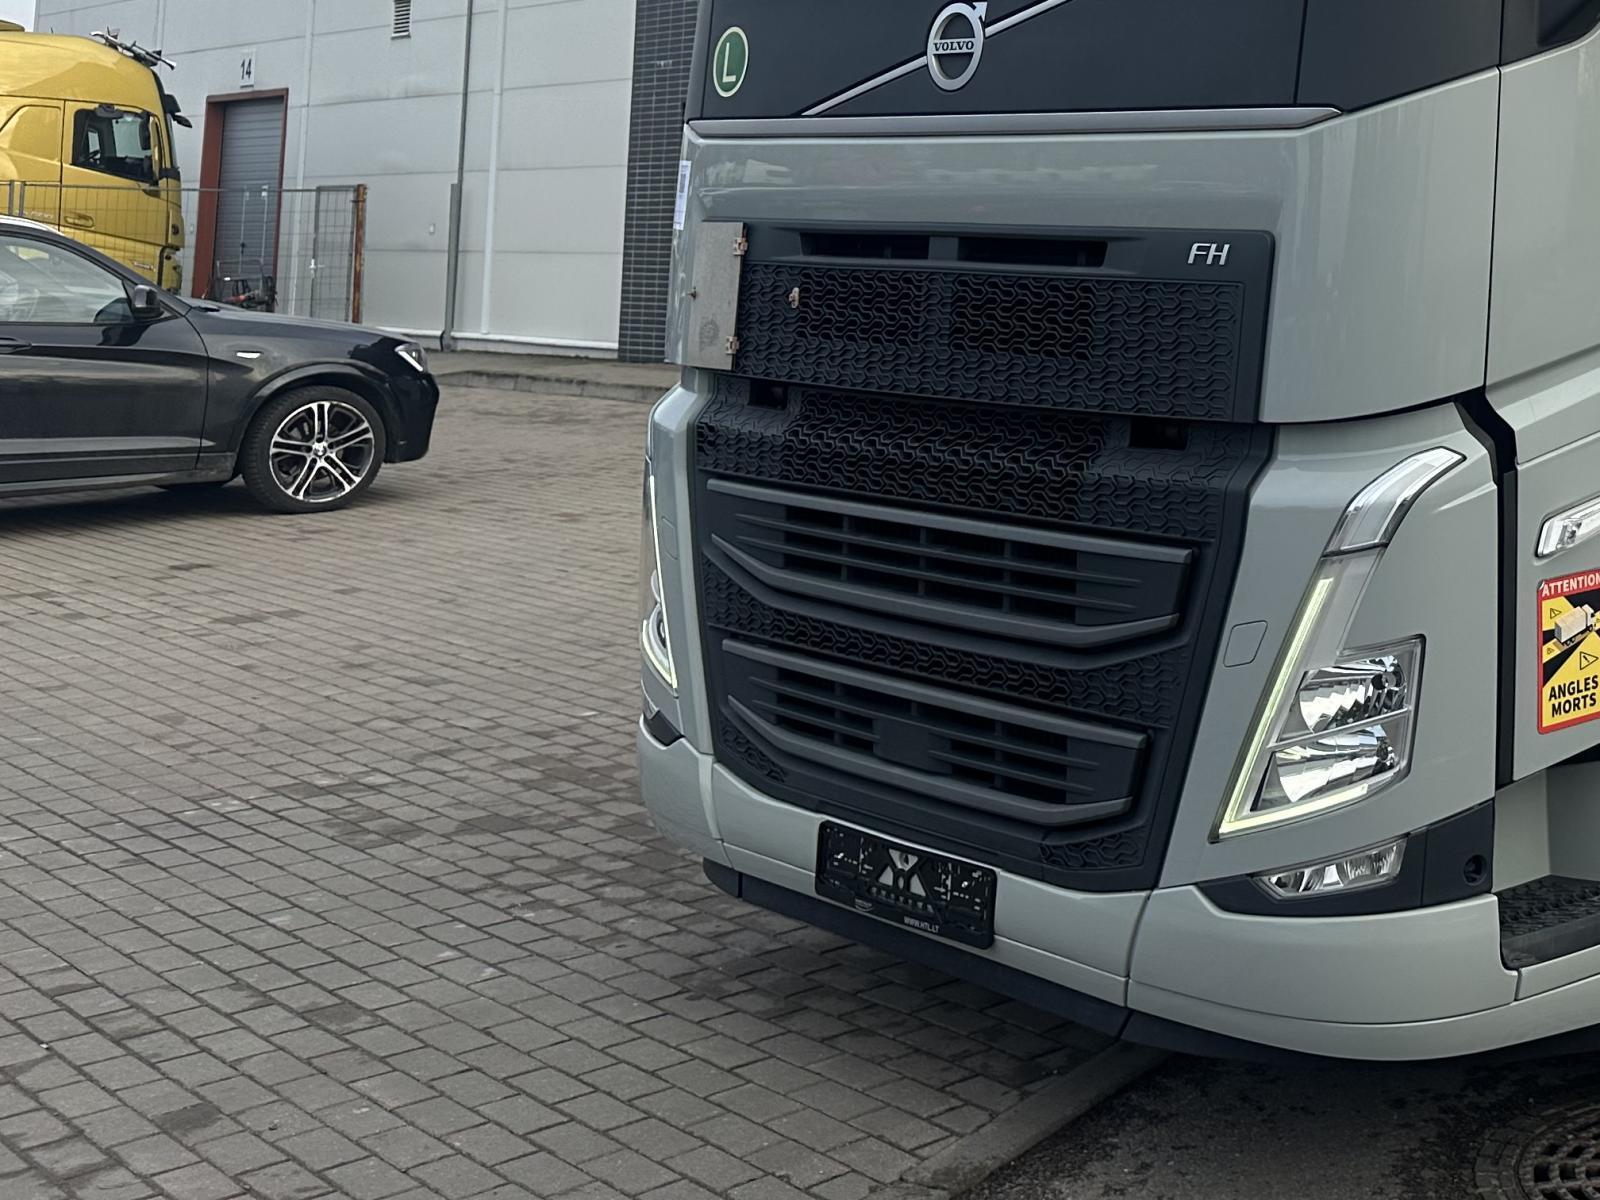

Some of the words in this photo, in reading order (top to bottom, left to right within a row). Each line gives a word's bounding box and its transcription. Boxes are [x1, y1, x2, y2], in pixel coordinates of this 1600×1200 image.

[932, 40, 975, 52] VOLVO
[240, 58, 252, 80] 14
[1187, 243, 1230, 265] FH
[1548, 675, 1599, 702] ANGLES
[1551, 692, 1597, 718] MORTS
